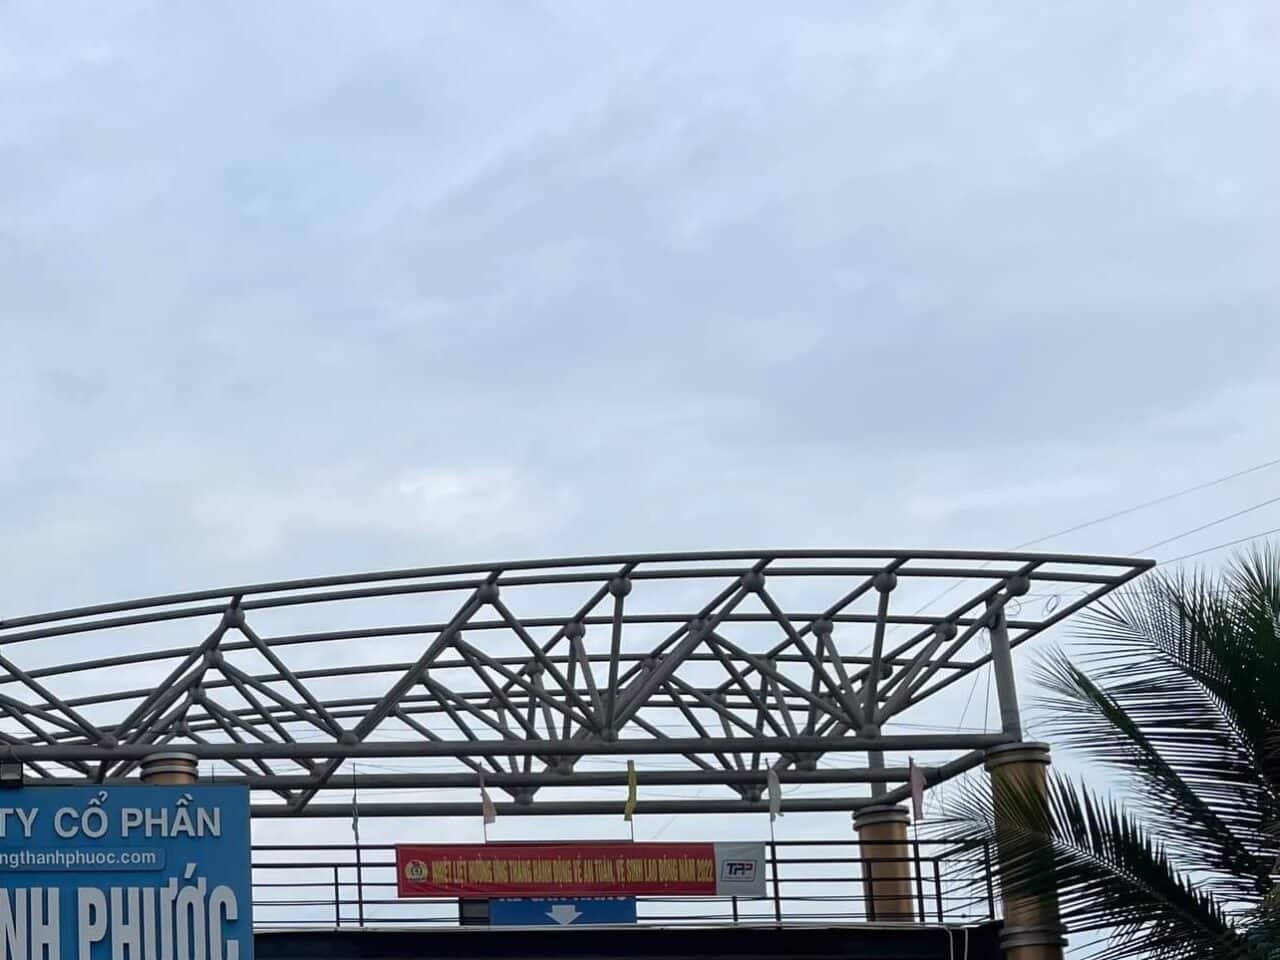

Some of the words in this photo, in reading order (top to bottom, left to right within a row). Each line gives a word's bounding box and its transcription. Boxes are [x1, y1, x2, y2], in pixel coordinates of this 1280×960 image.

[53, 790, 109, 839] CỔ
[120, 793, 222, 838] PHẦN
[726, 862, 754, 876] TPP
